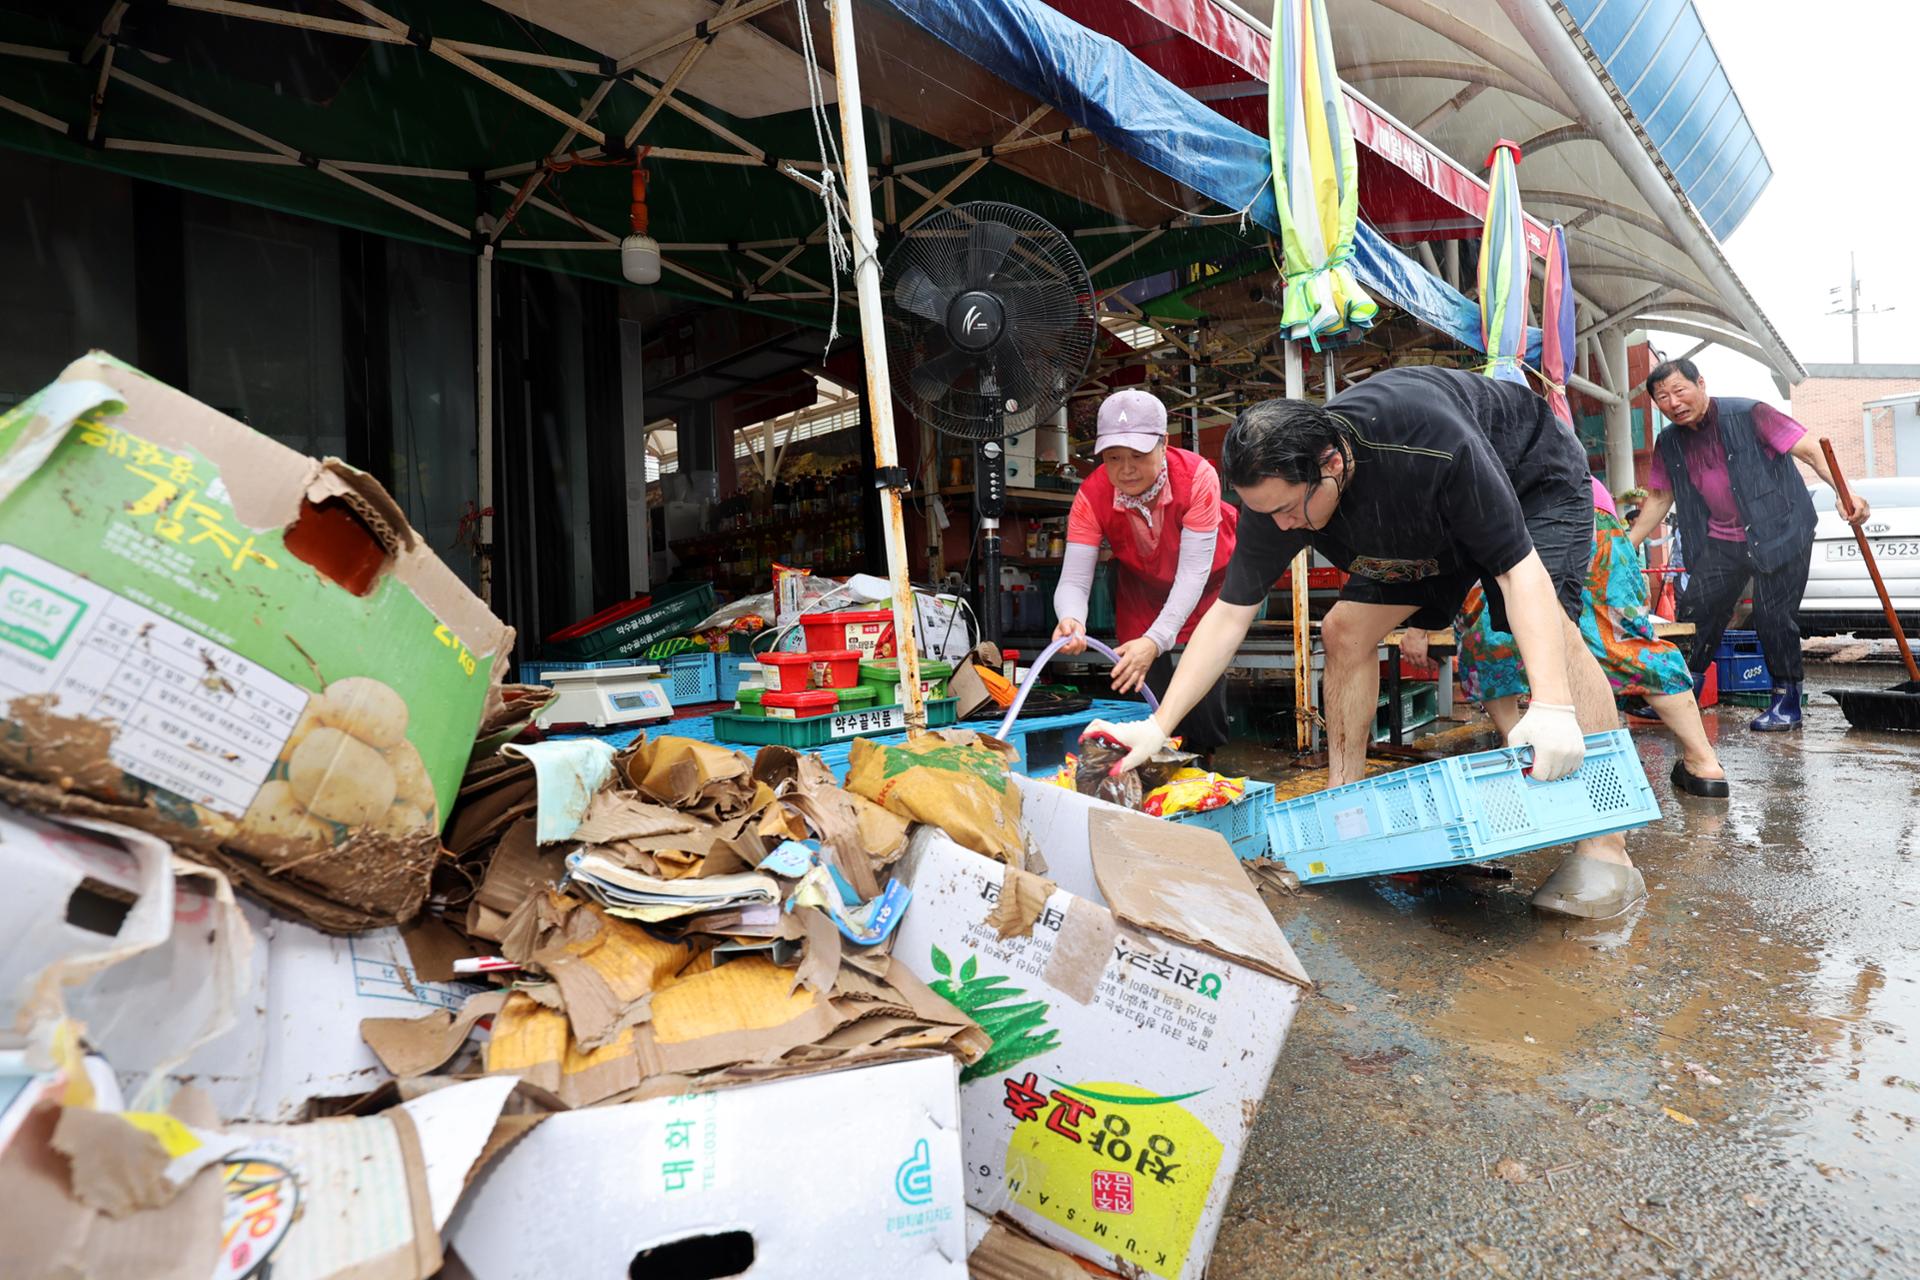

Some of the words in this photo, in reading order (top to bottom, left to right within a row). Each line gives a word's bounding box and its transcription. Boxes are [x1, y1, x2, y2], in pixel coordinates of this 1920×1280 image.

[1118, 411, 1128, 422] A
[126, 464, 278, 570] 감자
[1838, 544, 1861, 557] 15
[1876, 543, 1919, 556] 7523
[8, 586, 63, 618] GAP
[835, 710, 892, 733] 약수골식품
[1106, 1001, 1155, 1028] 청양고추는
[1153, 1006, 1173, 1020] 있고
[1177, 1016, 1197, 1031] 맛이
[1161, 1024, 1181, 1039] 금산
[1187, 1036, 1207, 1051] 진주
[1004, 1073, 1182, 1185] 청양고추
[1092, 1170, 1131, 1193] 금산
[1094, 1190, 1132, 1214] 진주
